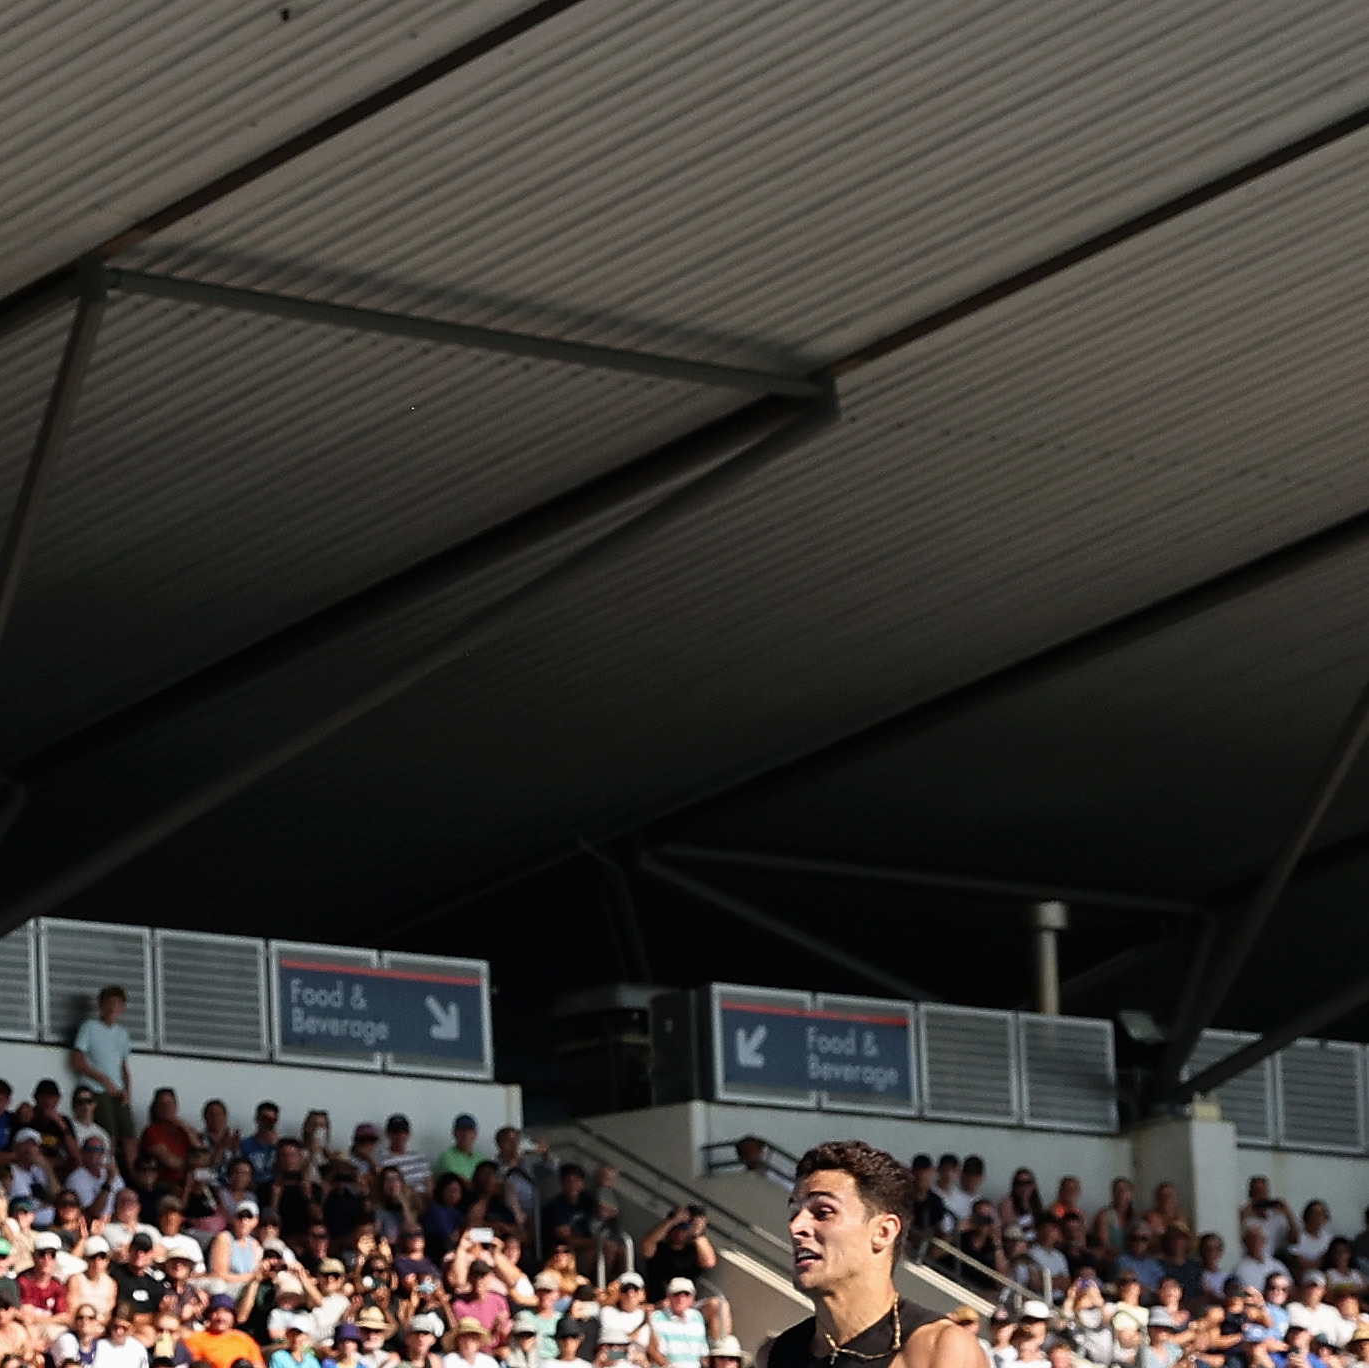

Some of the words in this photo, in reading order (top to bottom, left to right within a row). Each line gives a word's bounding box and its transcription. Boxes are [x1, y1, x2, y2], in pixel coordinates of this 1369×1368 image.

[291, 978, 344, 1008] Food
[350, 983, 367, 1010] &
[291, 1007, 389, 1046] Beverage
[806, 1026, 856, 1056] Food
[863, 1031, 880, 1057] &
[807, 1053, 899, 1092] Beverage
